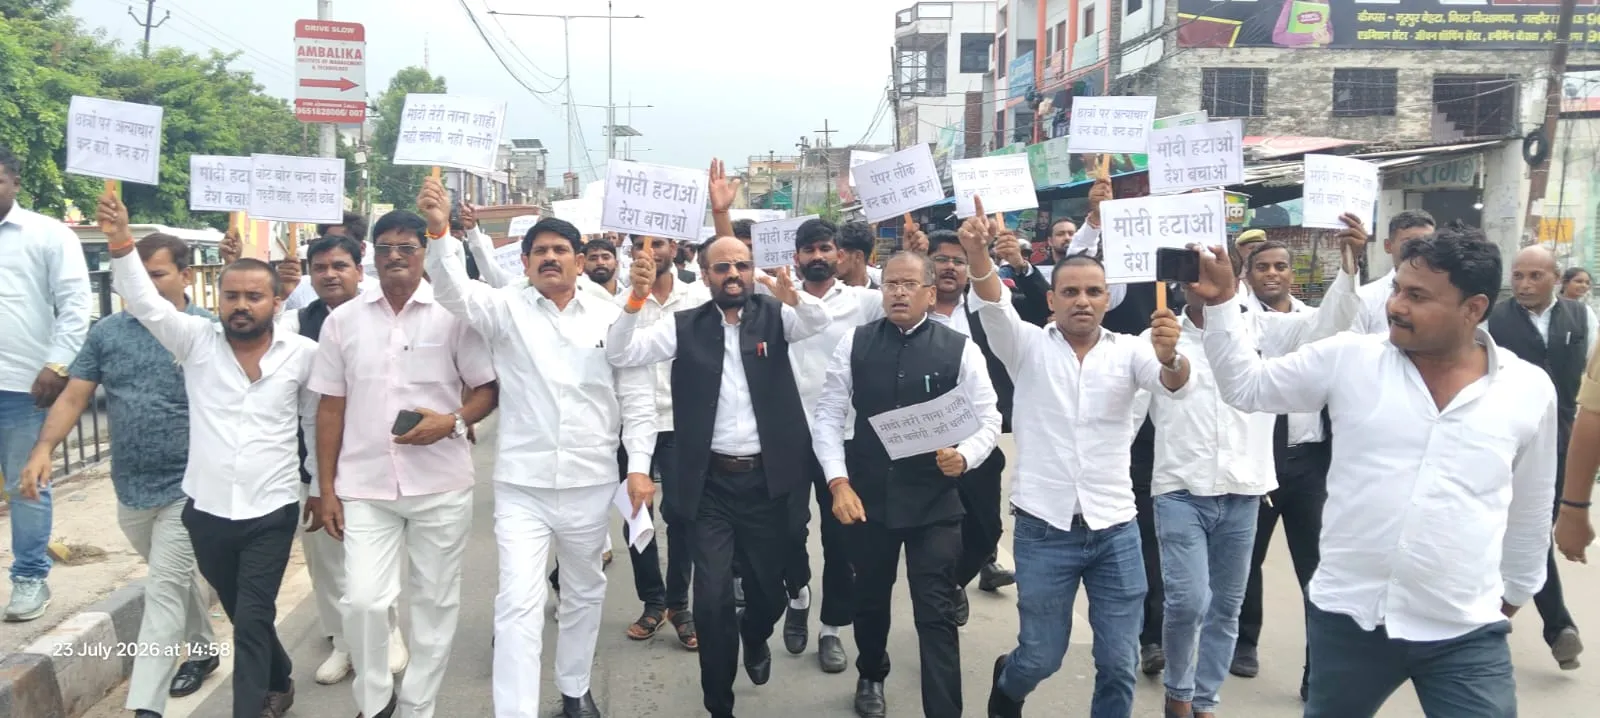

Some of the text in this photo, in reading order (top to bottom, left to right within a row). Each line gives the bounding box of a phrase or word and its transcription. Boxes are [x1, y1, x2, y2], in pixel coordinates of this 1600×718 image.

[304, 24, 355, 34] DRIVE SLOW
[297, 45, 363, 59] AMBALIKA
[1099, 108, 1110, 120] पर
[1157, 131, 1233, 157] मोदी हटाओ
[200, 162, 250, 184] मोदी हटा
[893, 161, 916, 178] लीक
[1164, 159, 1228, 183] देश बचाओ
[204, 185, 250, 206] देश बचा
[616, 169, 699, 205] मोदी हटाओ
[618, 200, 688, 233] देश बचाओ
[1113, 208, 1151, 237] मोदी
[1158, 204, 1214, 237] हटाओ
[758, 226, 780, 245] मोदी
[764, 248, 779, 262] देश
[1123, 244, 1149, 272] देश
